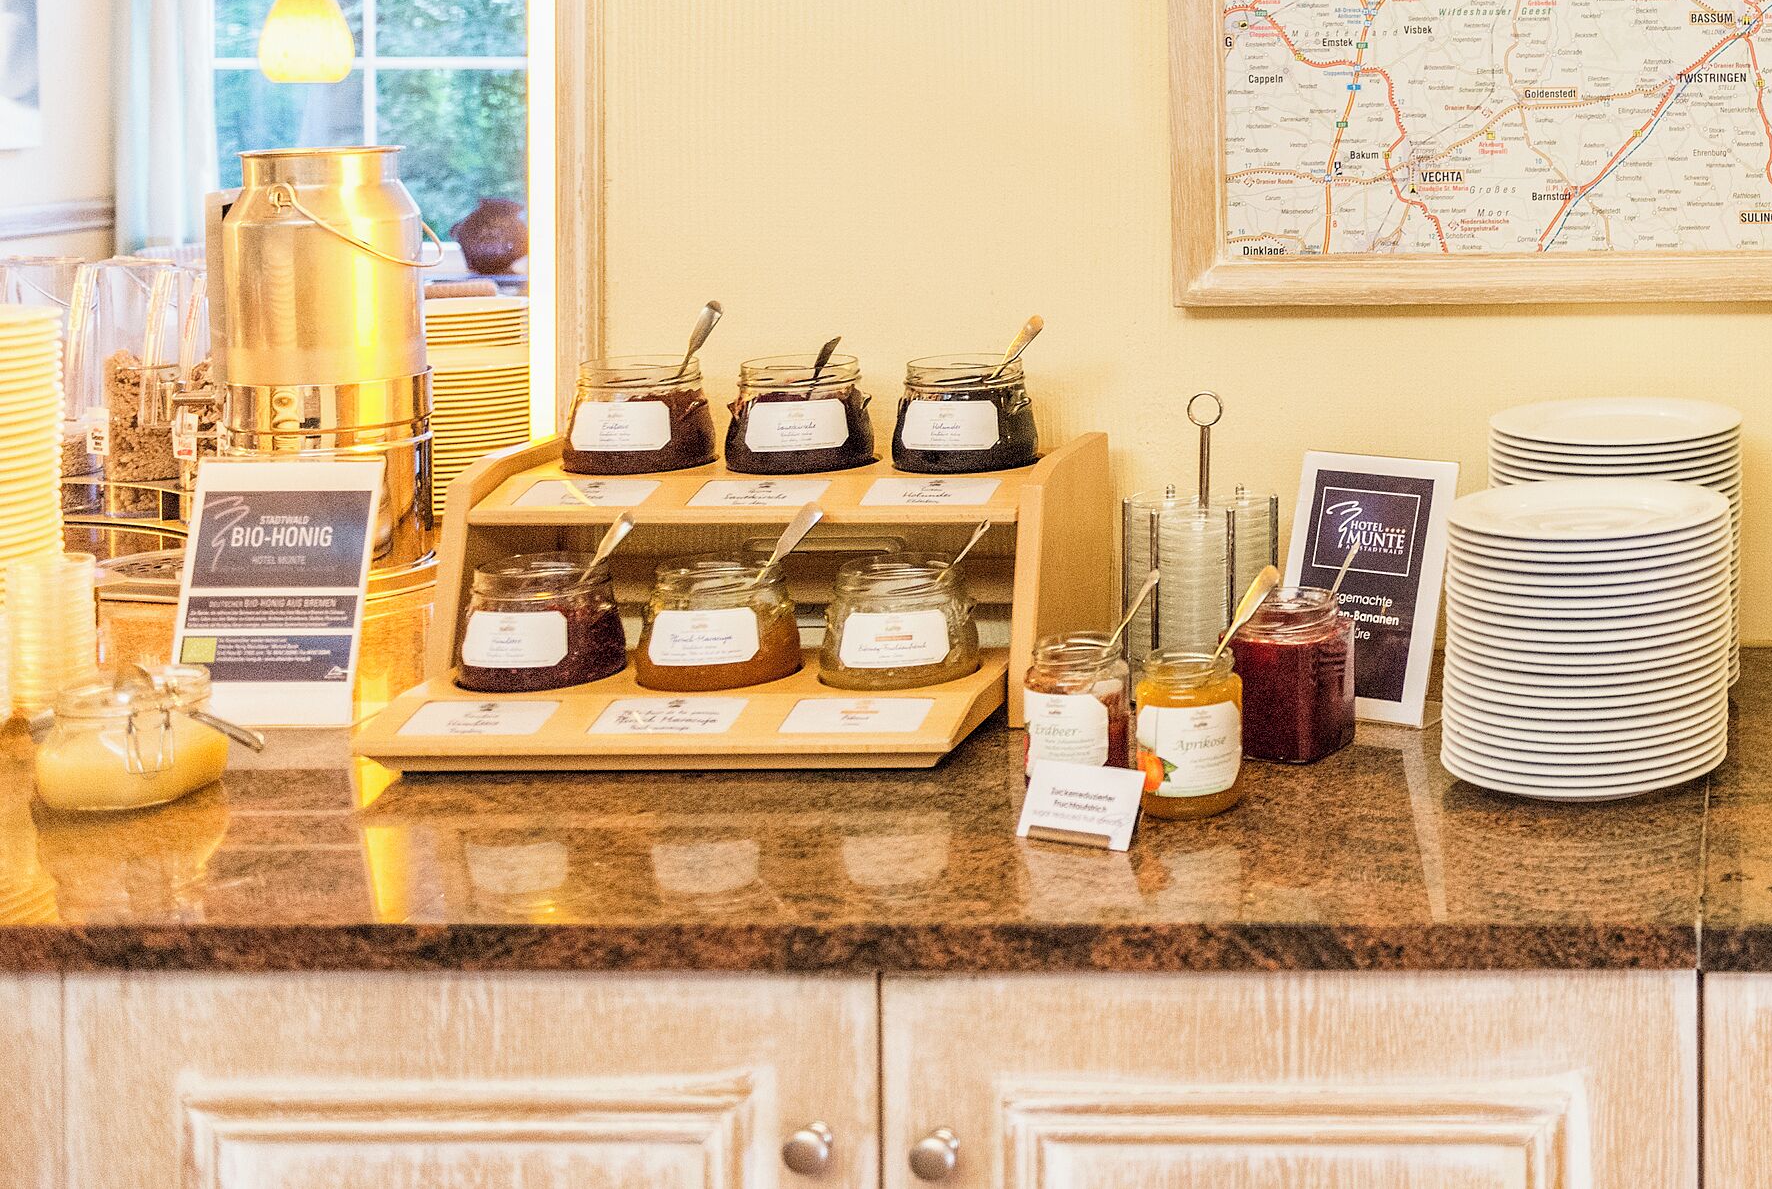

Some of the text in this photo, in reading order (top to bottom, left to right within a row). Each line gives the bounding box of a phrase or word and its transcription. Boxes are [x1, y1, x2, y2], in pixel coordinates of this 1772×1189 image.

[1691, 14, 1733, 23] BASSUM
[1404, 26, 1432, 34] Visbek
[1322, 38, 1353, 47] Emstek
[1249, 75, 1283, 85] Cappeln
[1678, 74, 1747, 83] TWISTRINGEN
[1525, 90, 1576, 98] Goldenstedt
[1350, 151, 1379, 159] Bakum
[1693, 149, 1727, 157] Ehrenburg
[1422, 172, 1463, 182] VECHTA
[1532, 192, 1570, 201] Barnstorf
[260, 516, 309, 525] STADTWALD
[1351, 520, 1383, 532] HOTEL
[231, 526, 333, 547] BIO-HONIG
[1346, 530, 1405, 549] MUNTE
[1360, 546, 1403, 555] STADTWALD
[1173, 735, 1226, 753] Aprikose
